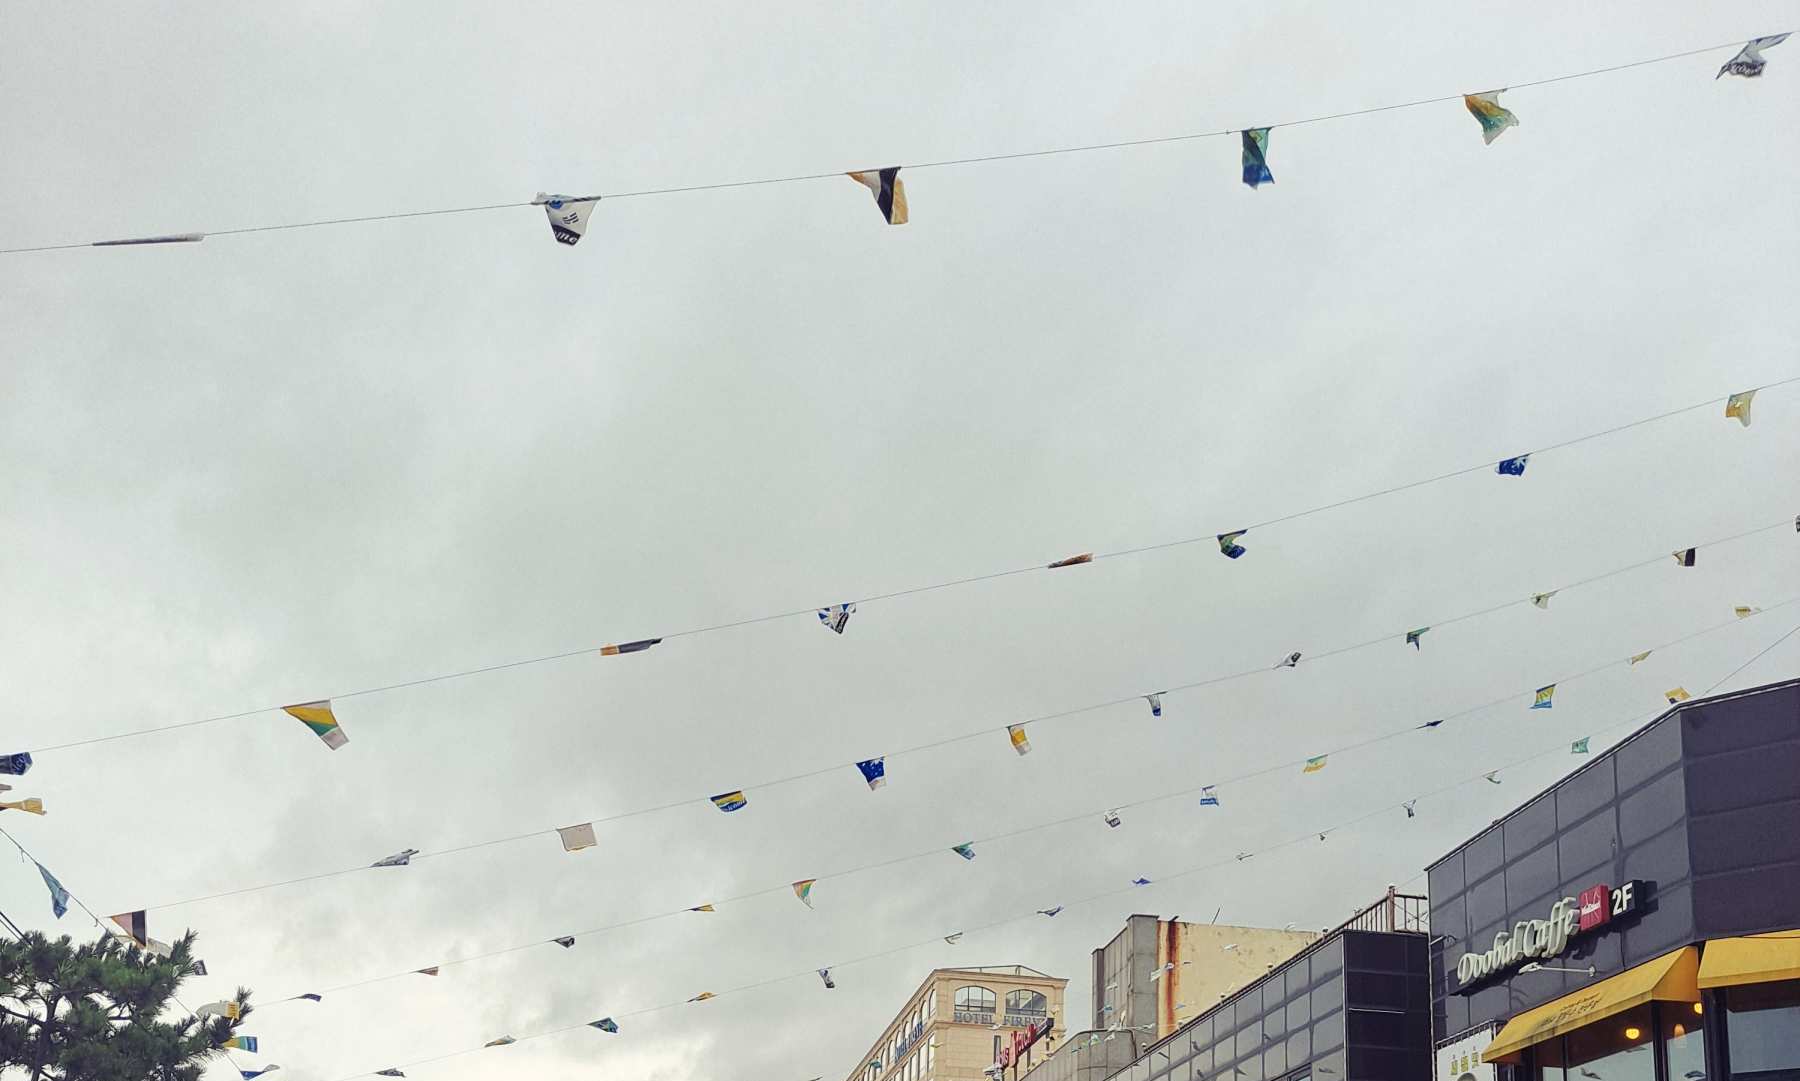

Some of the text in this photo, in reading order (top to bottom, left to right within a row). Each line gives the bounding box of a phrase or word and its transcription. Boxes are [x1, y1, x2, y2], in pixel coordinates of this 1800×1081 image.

[1457, 882, 1633, 985] Doobal Caffe 2F
